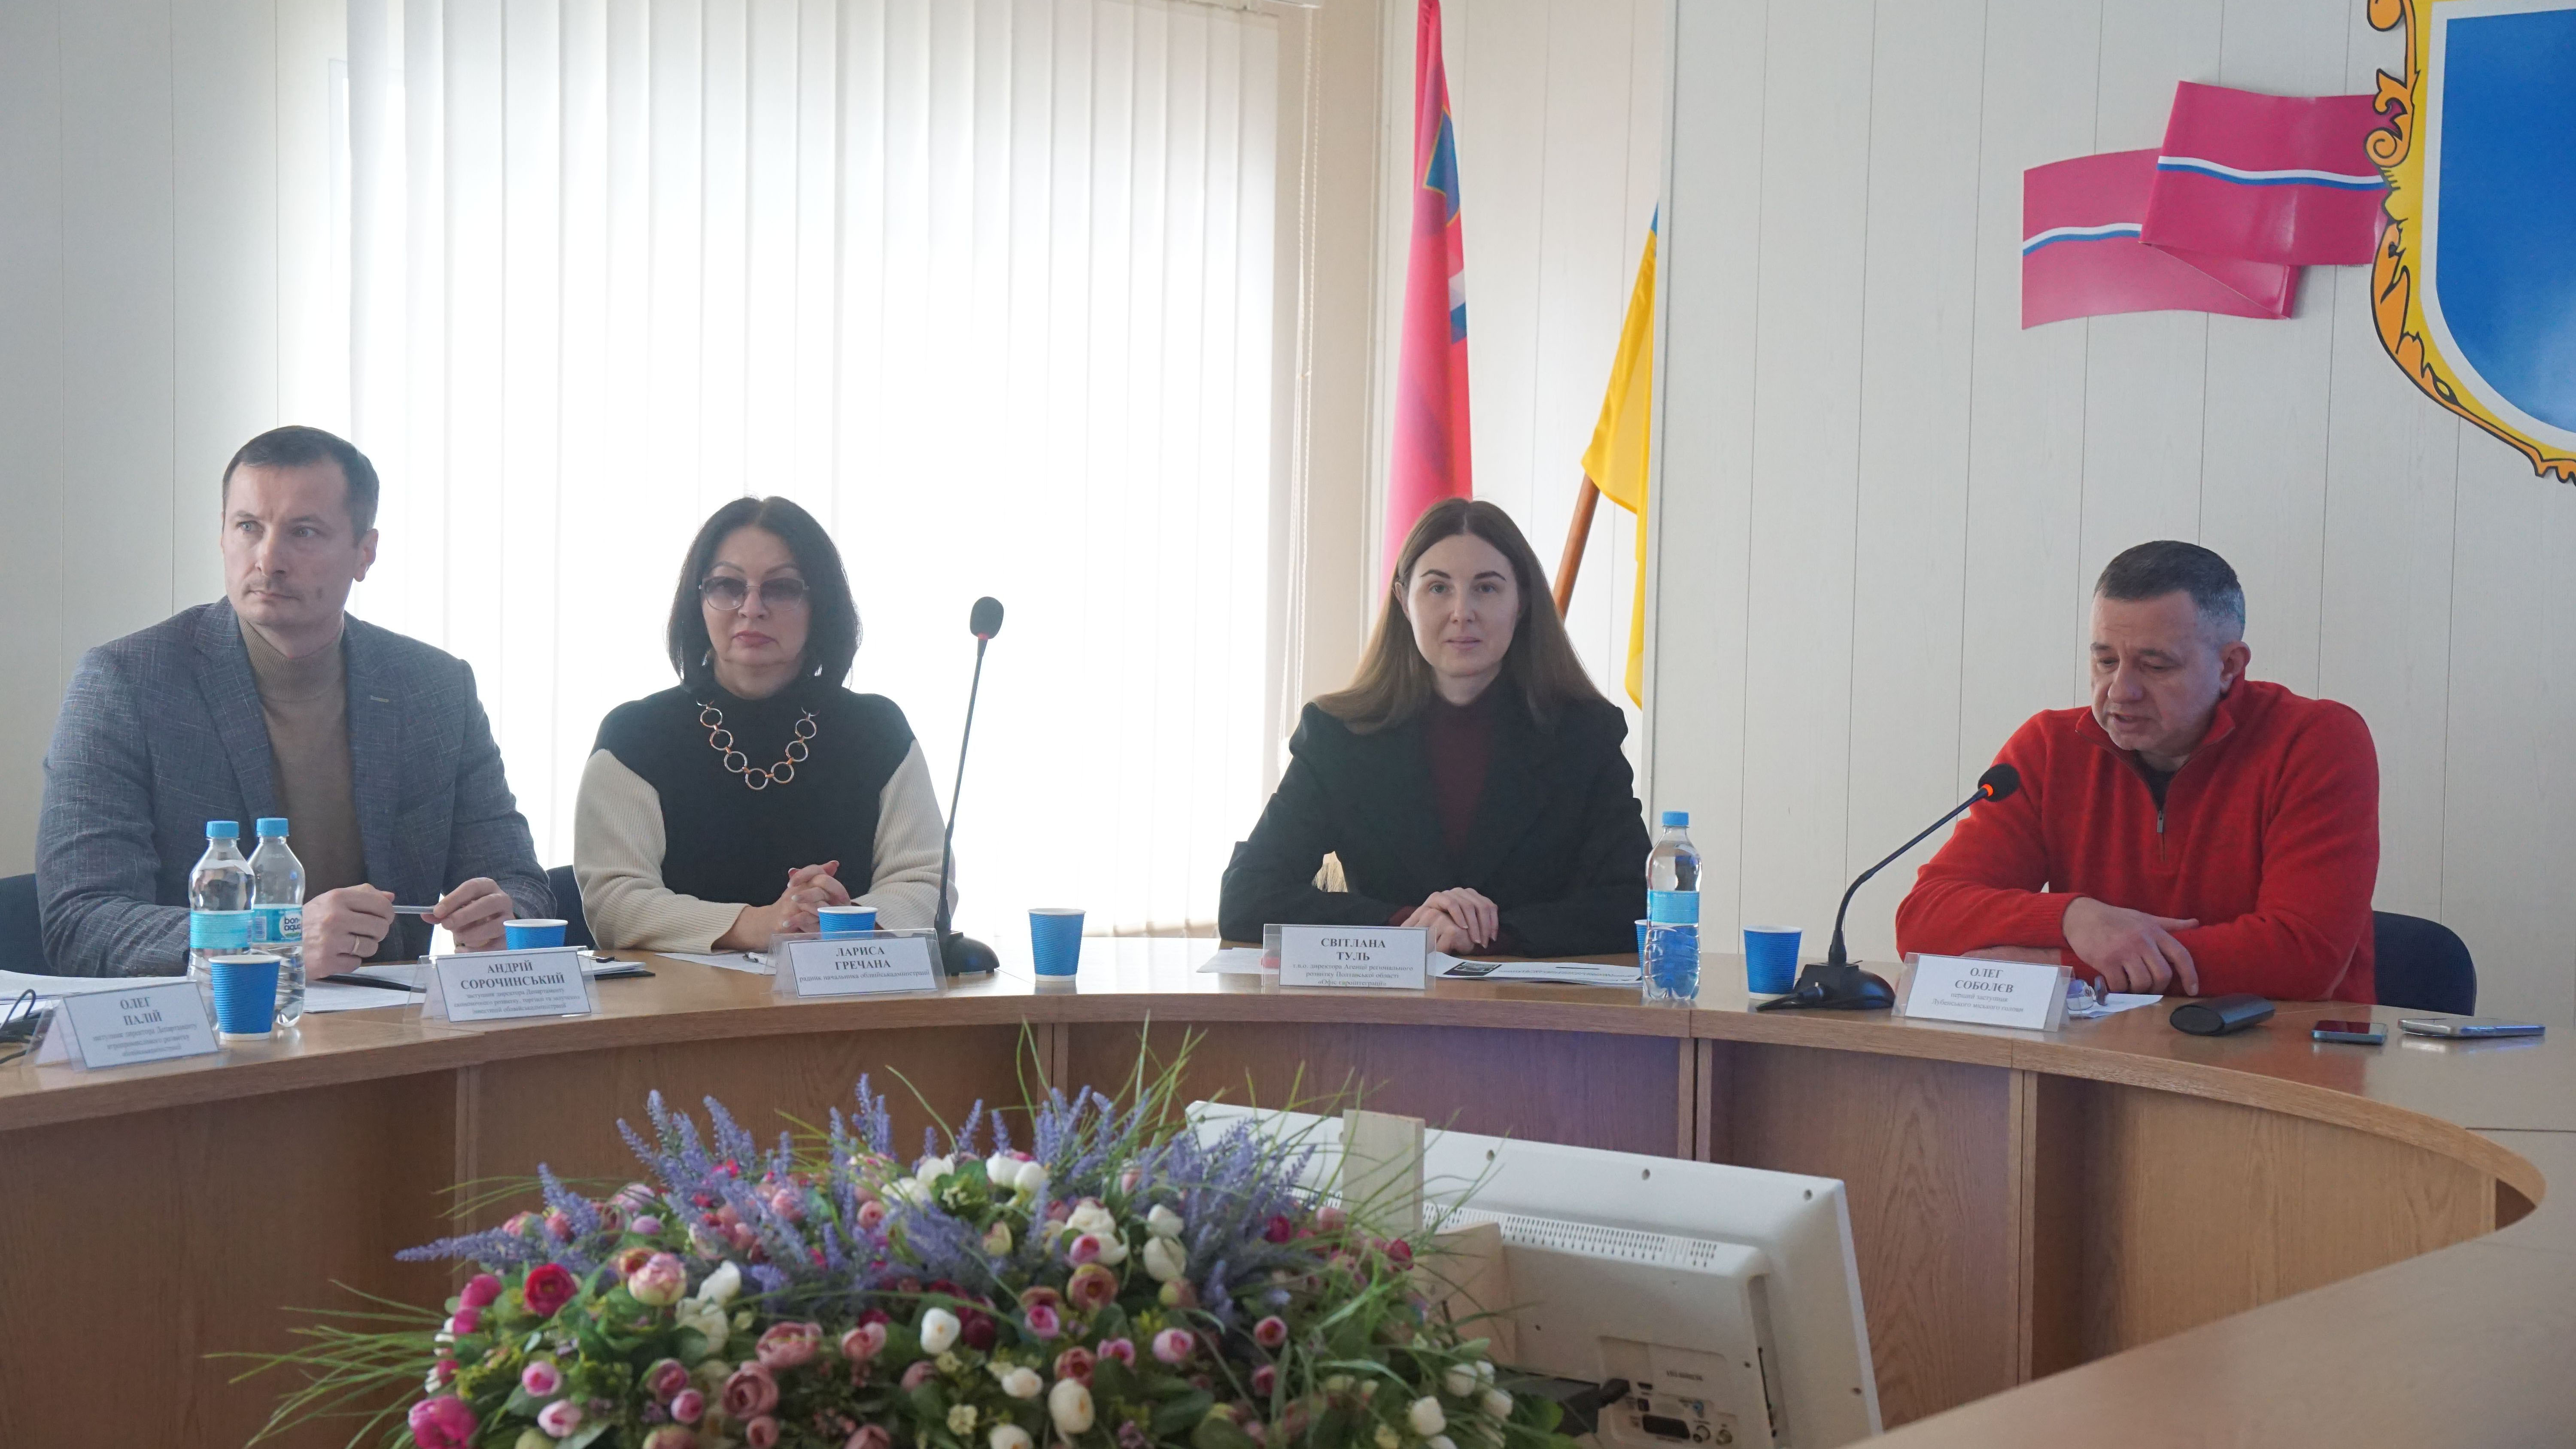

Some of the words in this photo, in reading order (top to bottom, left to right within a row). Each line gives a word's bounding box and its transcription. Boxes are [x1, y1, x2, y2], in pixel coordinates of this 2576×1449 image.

[1321, 938, 1386, 948] СВІТЛАНА
[835, 946, 885, 957] ЛАРИСА
[1336, 951, 1370, 961] ТУЛЬ
[487, 960, 534, 974] АНДРІЙ
[835, 959, 891, 971] ГРЕЧАНА
[1970, 967, 2003, 979] ОЛЕГ
[460, 972, 565, 990] СОРОЧИНСЬКИЙ
[1954, 979, 2014, 993] СОБОЛЄВ
[120, 996, 151, 1009] ОЛЕГ
[123, 1010, 163, 1026] ПАЛІЙ
